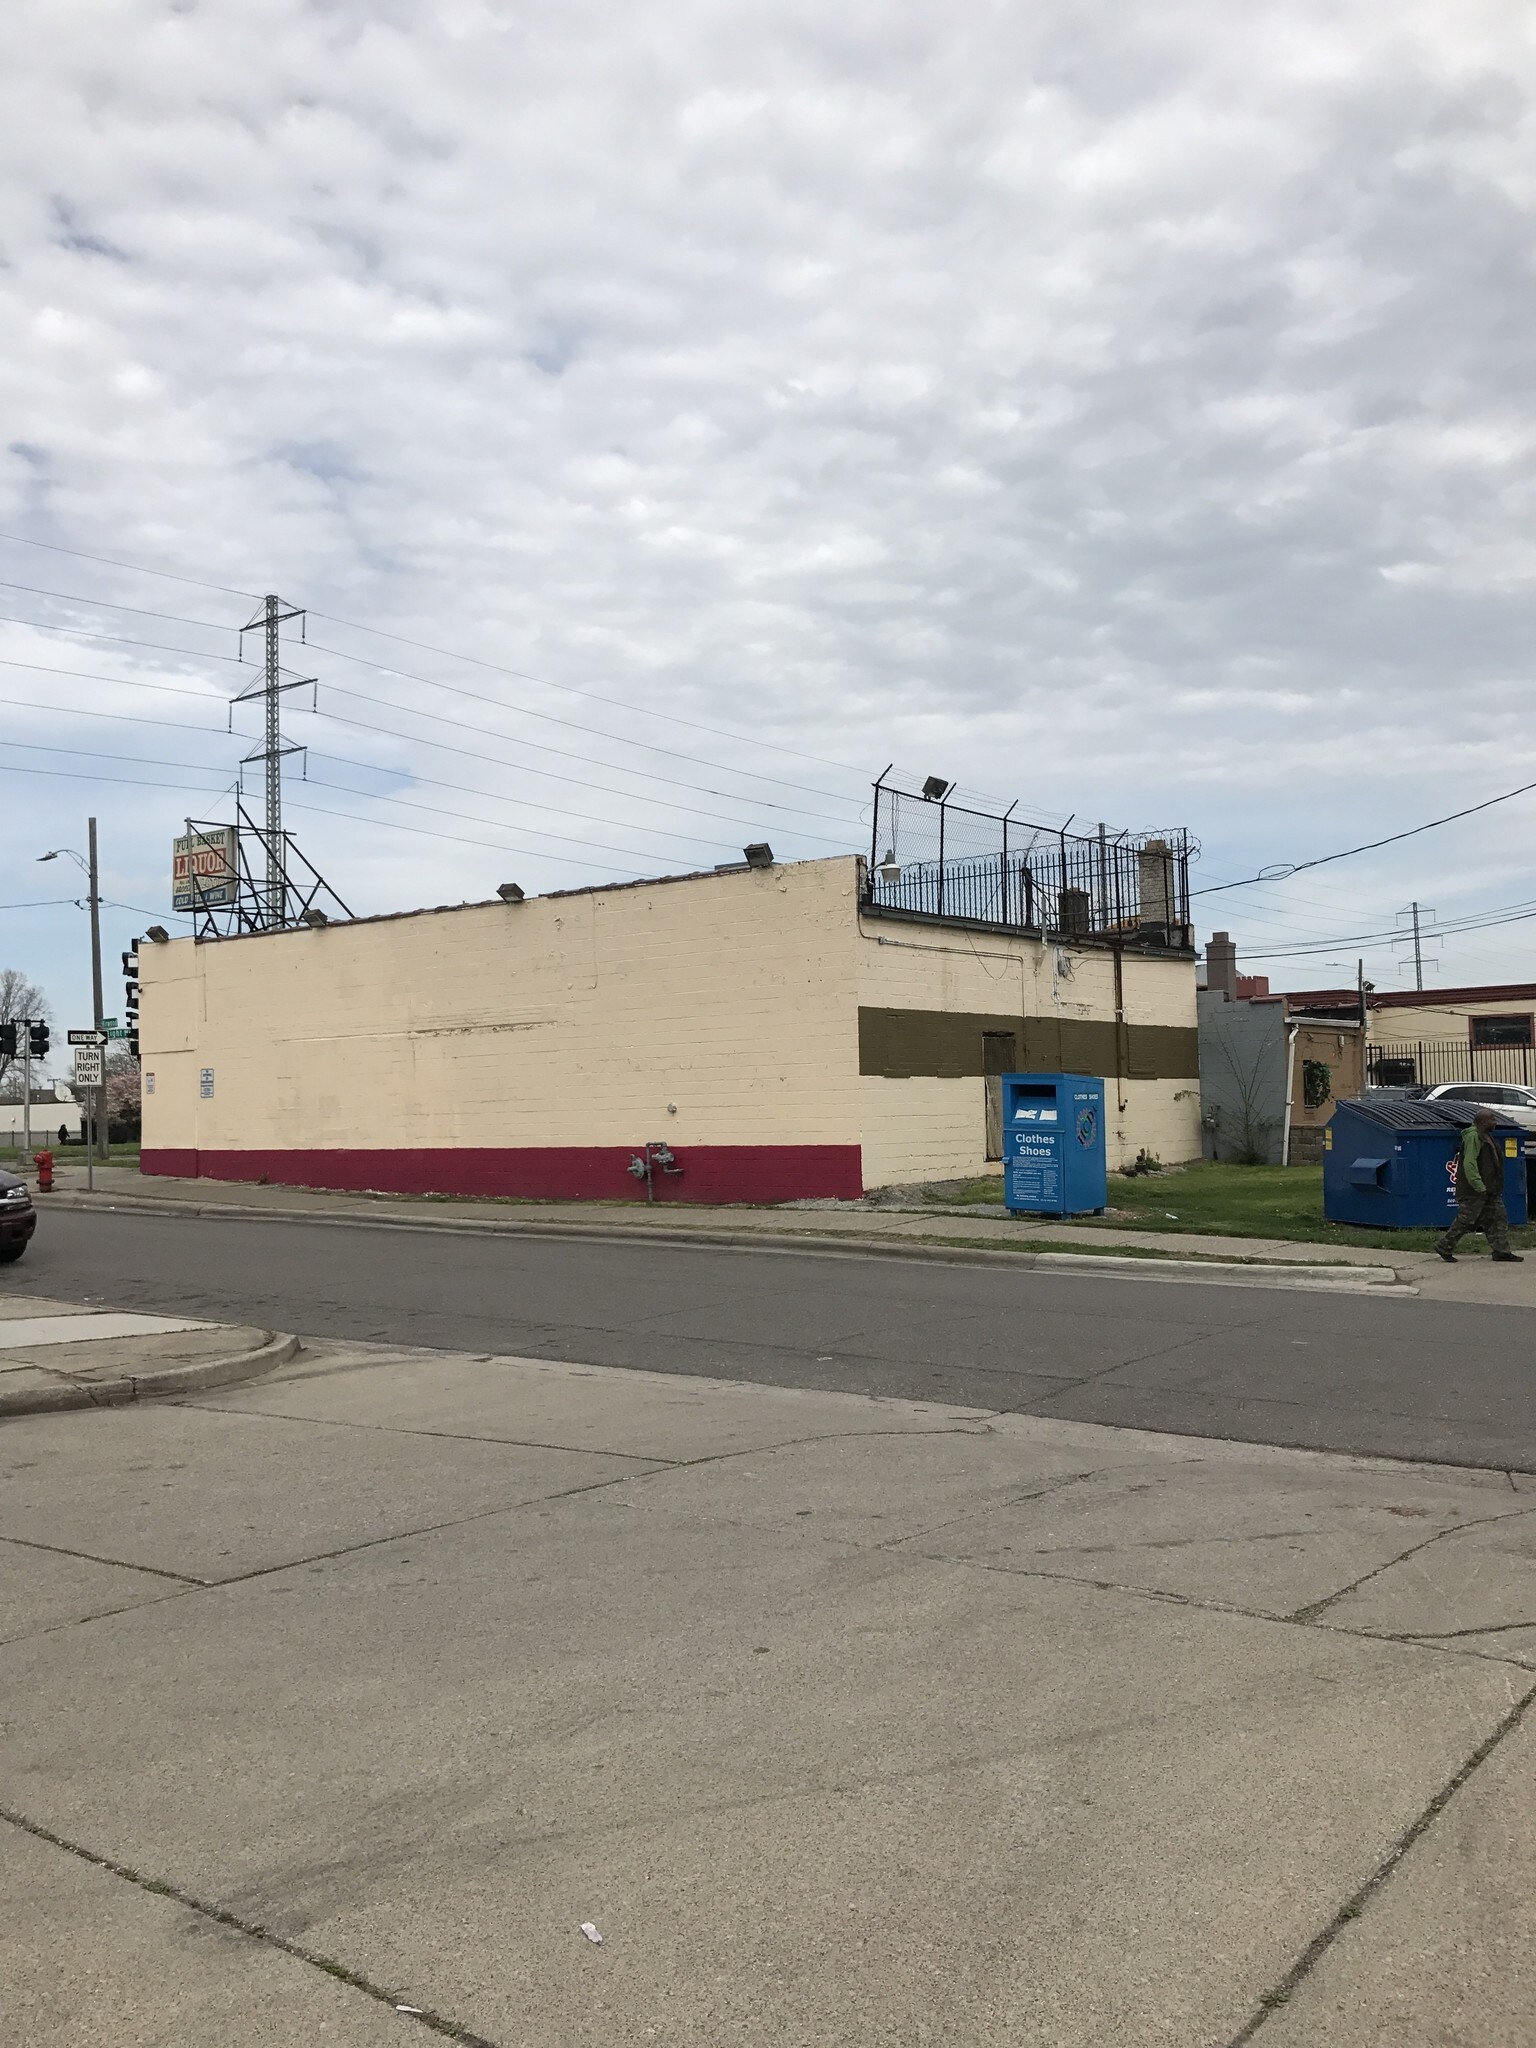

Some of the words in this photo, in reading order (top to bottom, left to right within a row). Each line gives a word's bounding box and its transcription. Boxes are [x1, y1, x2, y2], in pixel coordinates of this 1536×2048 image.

[197, 832, 224, 845] BASKET
[175, 850, 224, 877] LIQUOR
[78, 1051, 99, 1061] TURN
[77, 1062, 100, 1072] RIGHT
[78, 1073, 99, 1083] ONLY
[1015, 1134, 1055, 1144] Clothes
[1019, 1146, 1051, 1156] Shoes
